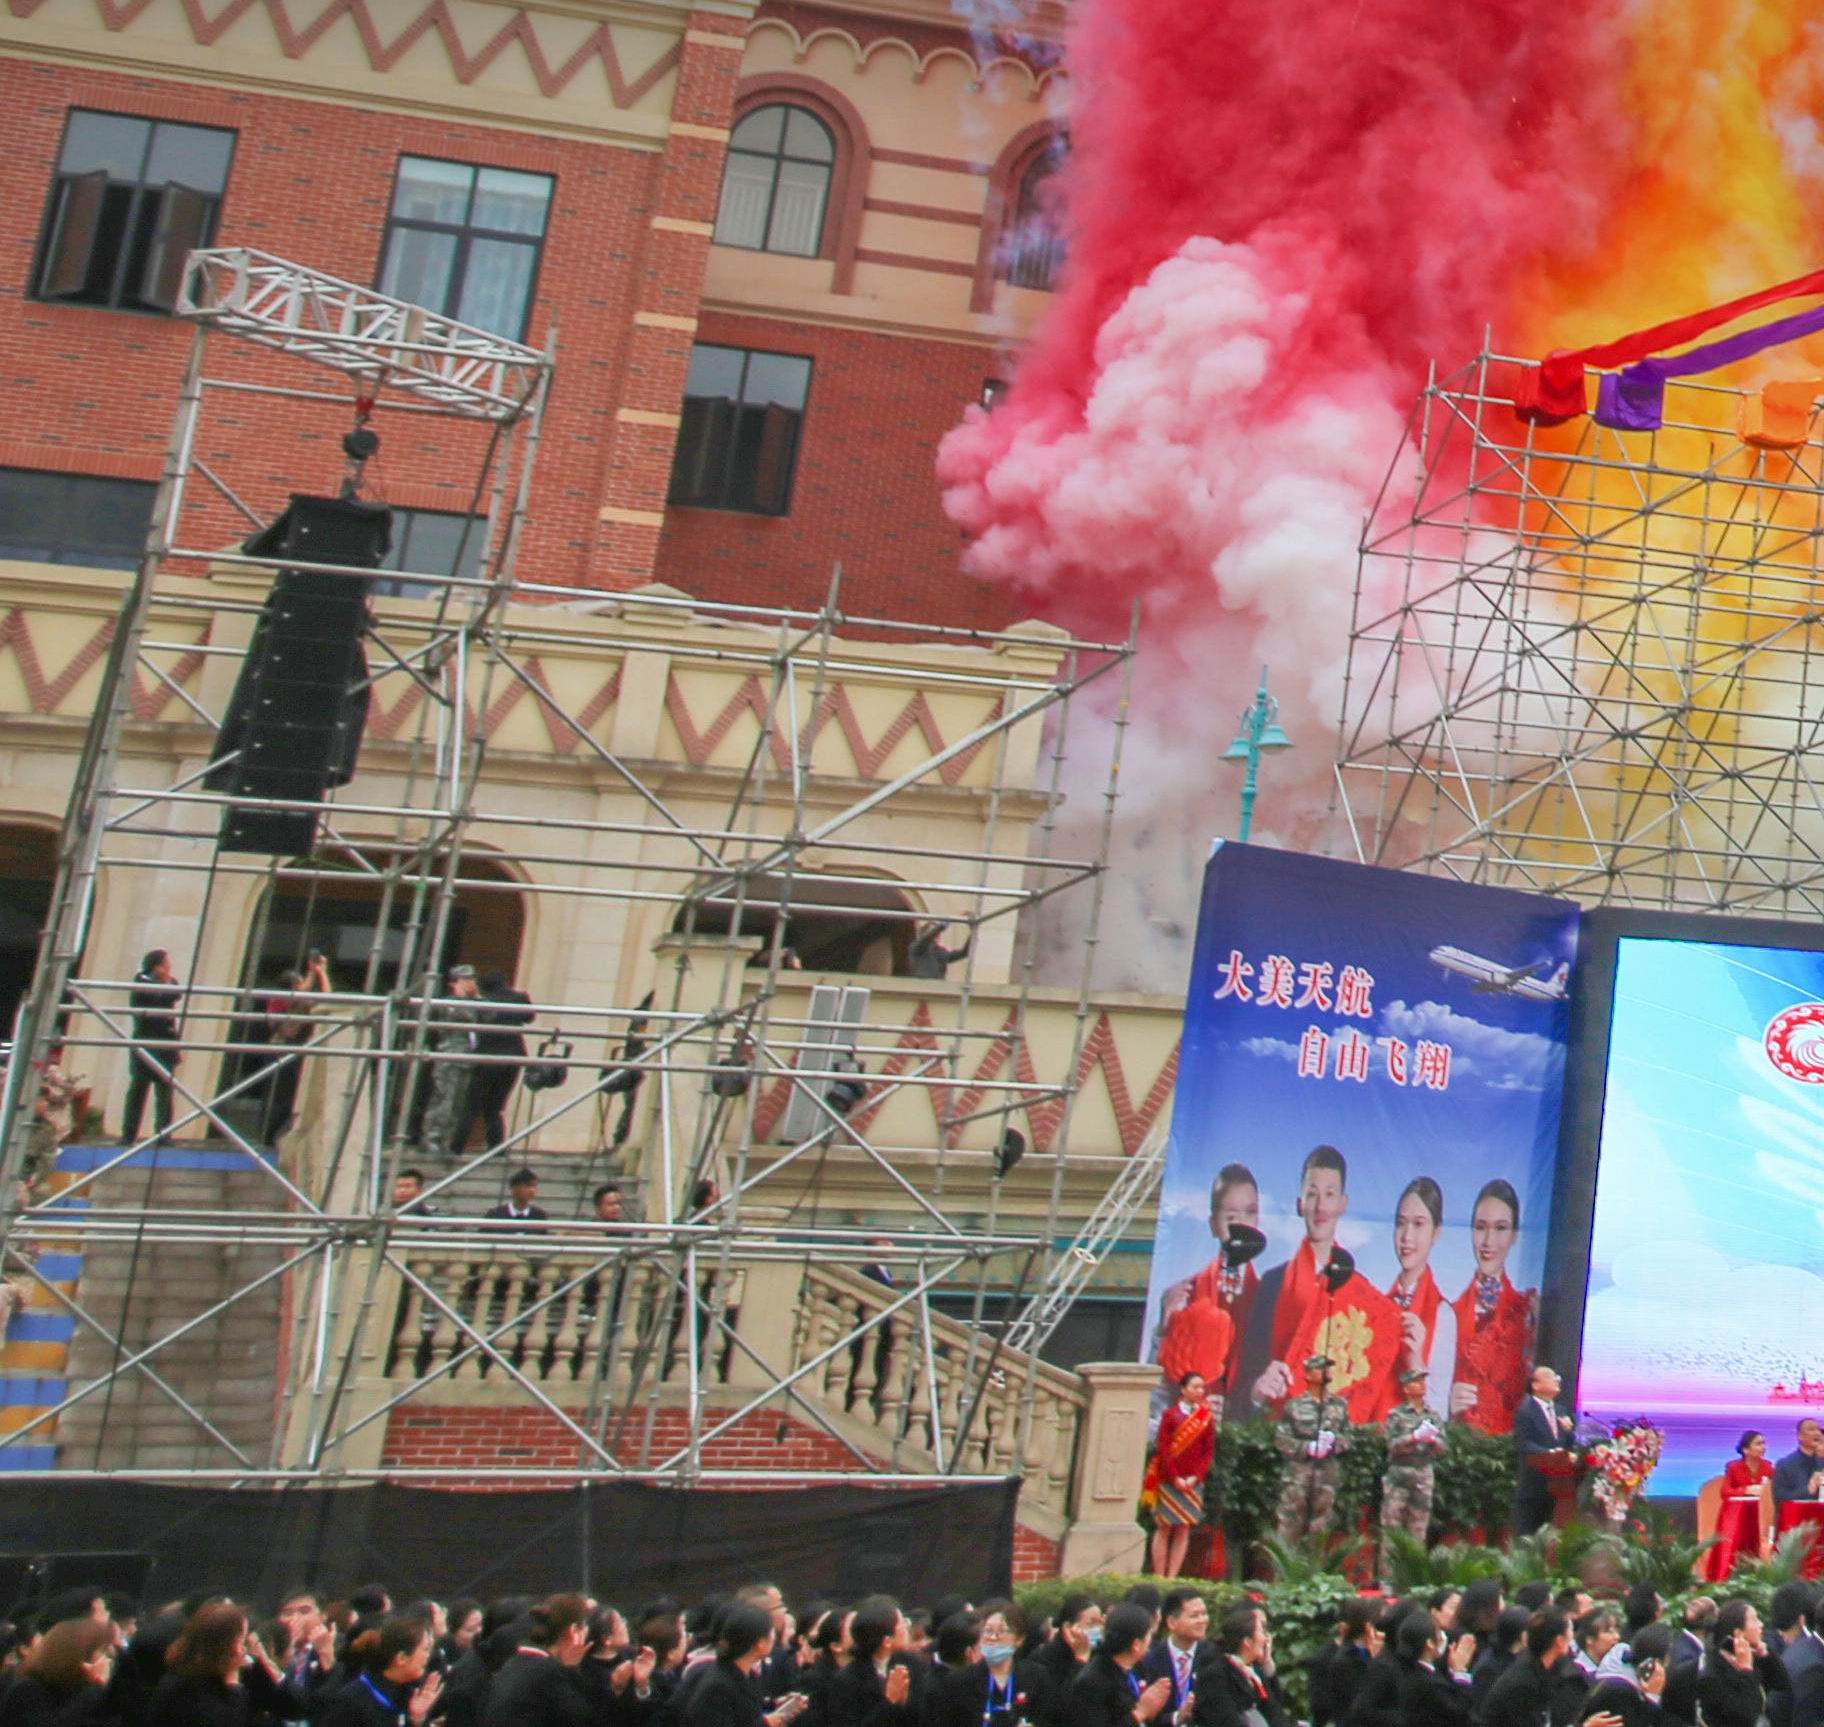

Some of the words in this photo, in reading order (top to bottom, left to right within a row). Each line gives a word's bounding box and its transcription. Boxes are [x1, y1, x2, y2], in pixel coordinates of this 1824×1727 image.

[1214, 950, 1375, 1018] 大美天航
[1298, 1025, 1452, 1090] 自由飞翔
